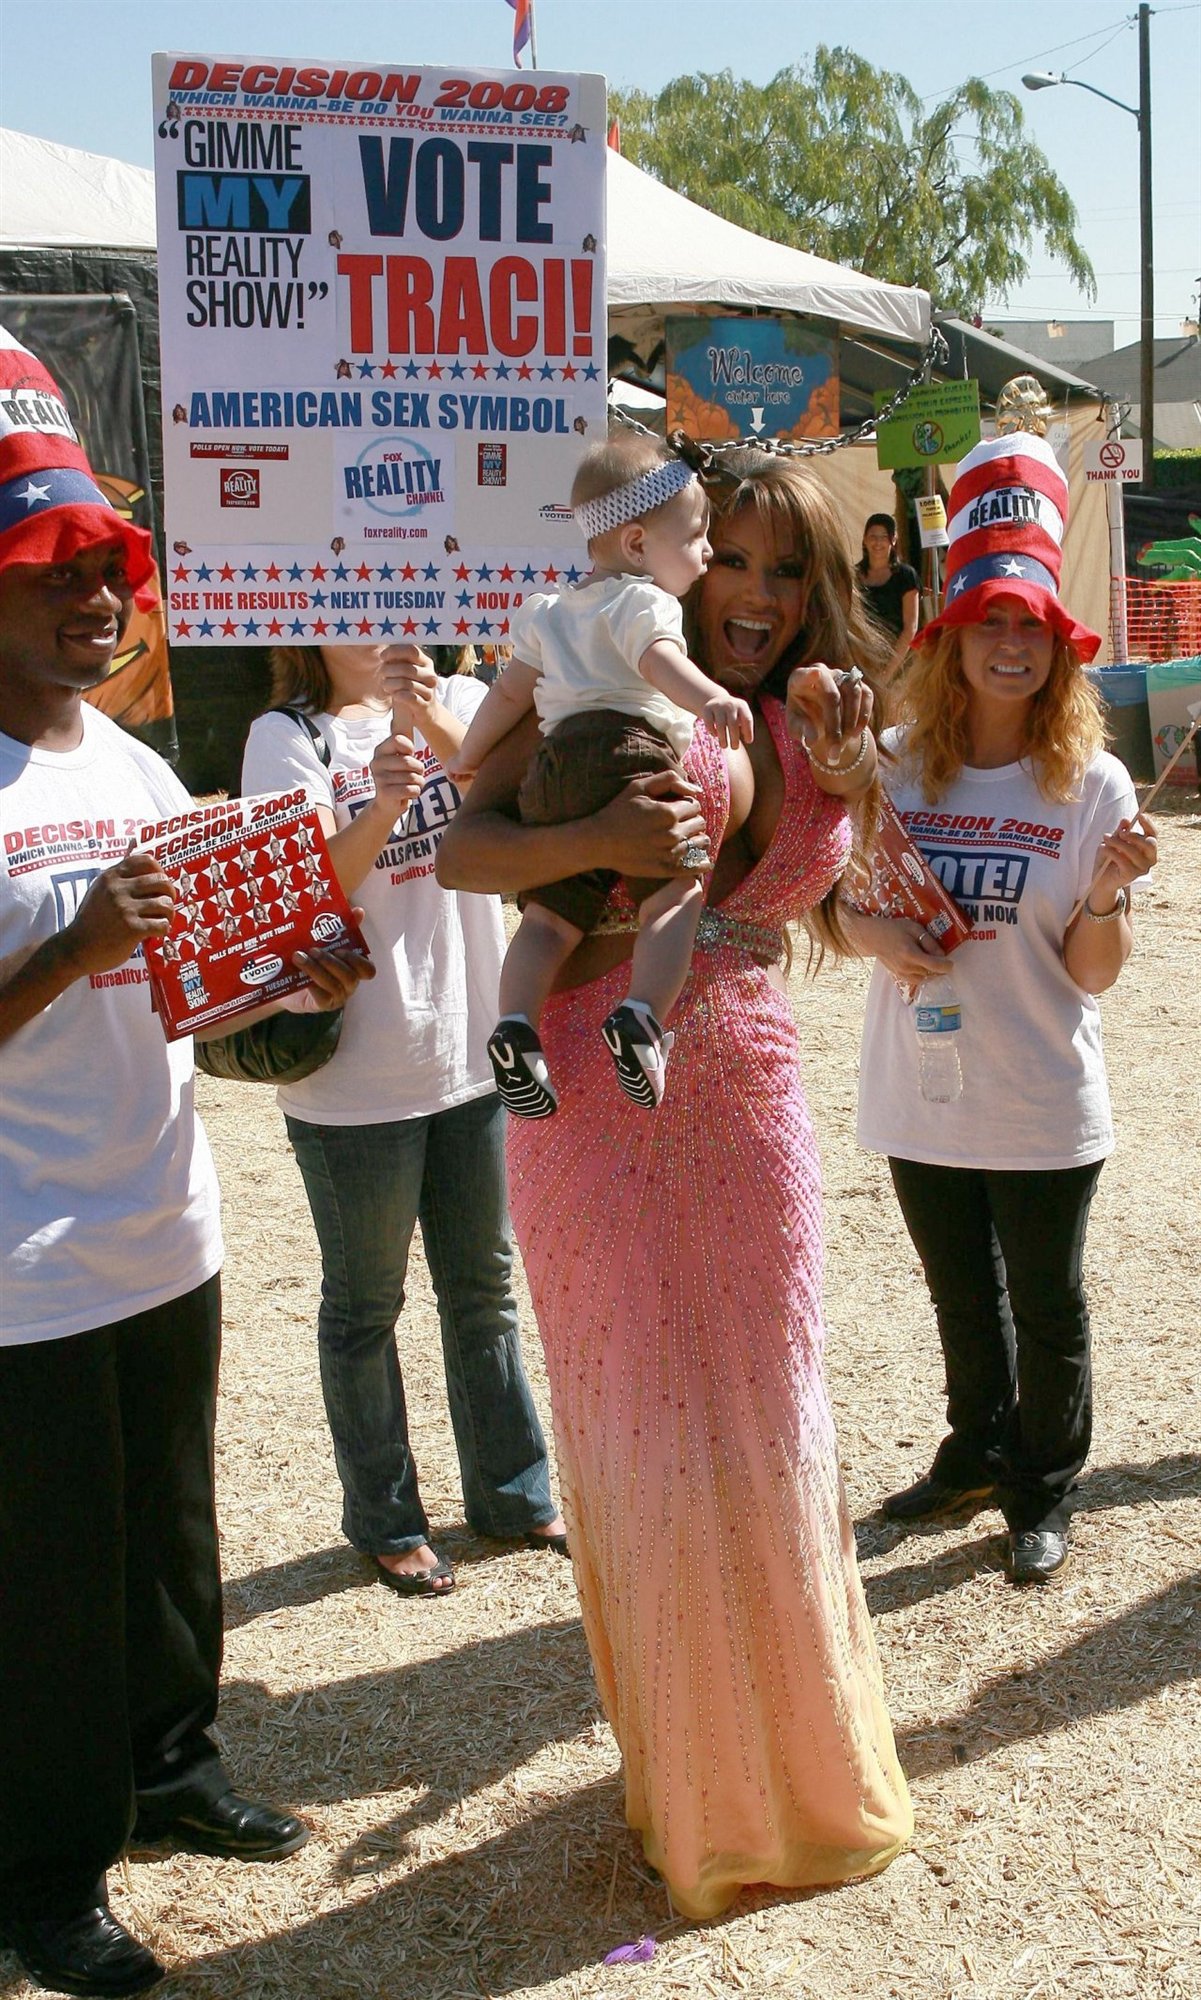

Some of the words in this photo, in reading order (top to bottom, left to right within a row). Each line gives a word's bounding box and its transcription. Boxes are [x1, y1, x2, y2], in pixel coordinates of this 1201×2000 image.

[168, 61, 422, 103] DECISION
[433, 79, 570, 113] 2008
[169, 91, 237, 105] WHICH
[243, 95, 354, 113] WANNA-BE
[360, 101, 388, 115] DO
[395, 103, 434, 120] YOU
[440, 109, 514, 125] WANNA
[520, 113, 568, 127] SEE?
[358, 135, 553, 244] VOTE
[184, 175, 303, 229] MY
[186, 235, 304, 278] REALITY
[337, 254, 593, 357] TRACI!
[708, 346, 803, 387] Welcome
[726, 390, 759, 404] enter
[763, 385, 791, 404] here
[189, 390, 362, 428] AMERICAN
[371, 391, 430, 428] SEX
[438, 395, 569, 434] SYMBOL
[383, 452, 403, 462] FOX
[224, 480, 256, 493] REALITY
[344, 459, 440, 499] REALITY
[1086, 470, 1117, 480] THANK
[1121, 469, 1140, 479] YOU
[406, 491, 445, 505] CHANNEL
[996, 488, 1012, 497] FOX
[968, 495, 1041, 530] REALITY
[364, 527, 428, 539] foxreality.com
[170, 592, 199, 610] SEE
[203, 592, 233, 610] THE
[237, 592, 308, 610] RESULTS
[331, 591, 370, 609] NEXT
[374, 591, 445, 608] TUESDAY
[477, 592, 510, 610] NOV
[250, 788, 307, 823] 2008
[169, 838, 217, 865] WANNA-BE
[220, 832, 232, 842] DO
[234, 823, 252, 837] YOU
[255, 812, 287, 829] WANNA
[289, 802, 310, 815] SEE?
[909, 826, 960, 838] WANNA-BE
[962, 829, 976, 838] DO
[979, 831, 997, 839] YOU
[999, 832, 1034, 843] WANNA
[1036, 838, 1060, 850] SEE?
[999, 818, 1064, 842] 2008
[8, 847, 45, 867] WHICH
[49, 838, 102, 854] WANNA-B
[106, 837, 127, 848] YOU
[927, 855, 1023, 899] OTE!
[984, 904, 1018, 925] NOW
[259, 930, 274, 941] VOTE
[310, 916, 344, 941] REALITY
[249, 961, 280, 977] VOTED!
[184, 976, 201, 992] MY
[265, 975, 293, 993] TUESDAY
